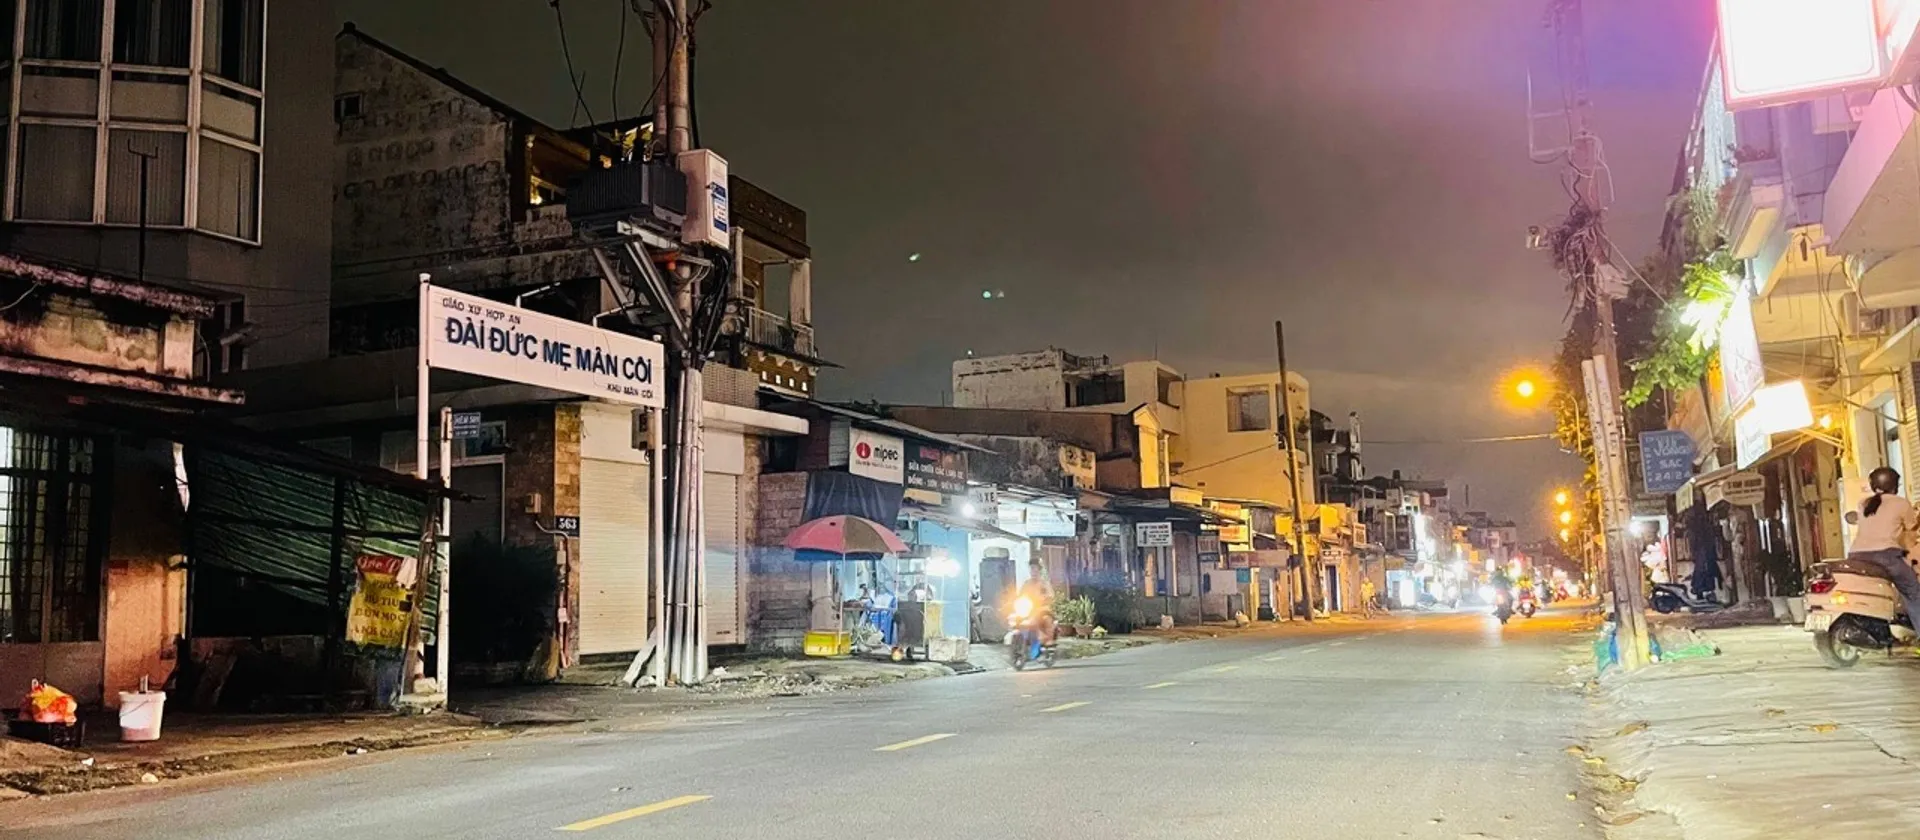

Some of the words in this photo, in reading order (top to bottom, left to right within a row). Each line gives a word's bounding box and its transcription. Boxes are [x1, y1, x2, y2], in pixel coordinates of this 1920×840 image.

[508, 314, 521, 325] AN
[445, 316, 485, 350] ĐÀI
[489, 324, 538, 360] ĐỨC
[543, 338, 572, 371] MẸ
[576, 346, 618, 378] MÂN
[622, 355, 652, 385] CÔI
[873, 444, 899, 462] mipec
[558, 518, 577, 530] 563
